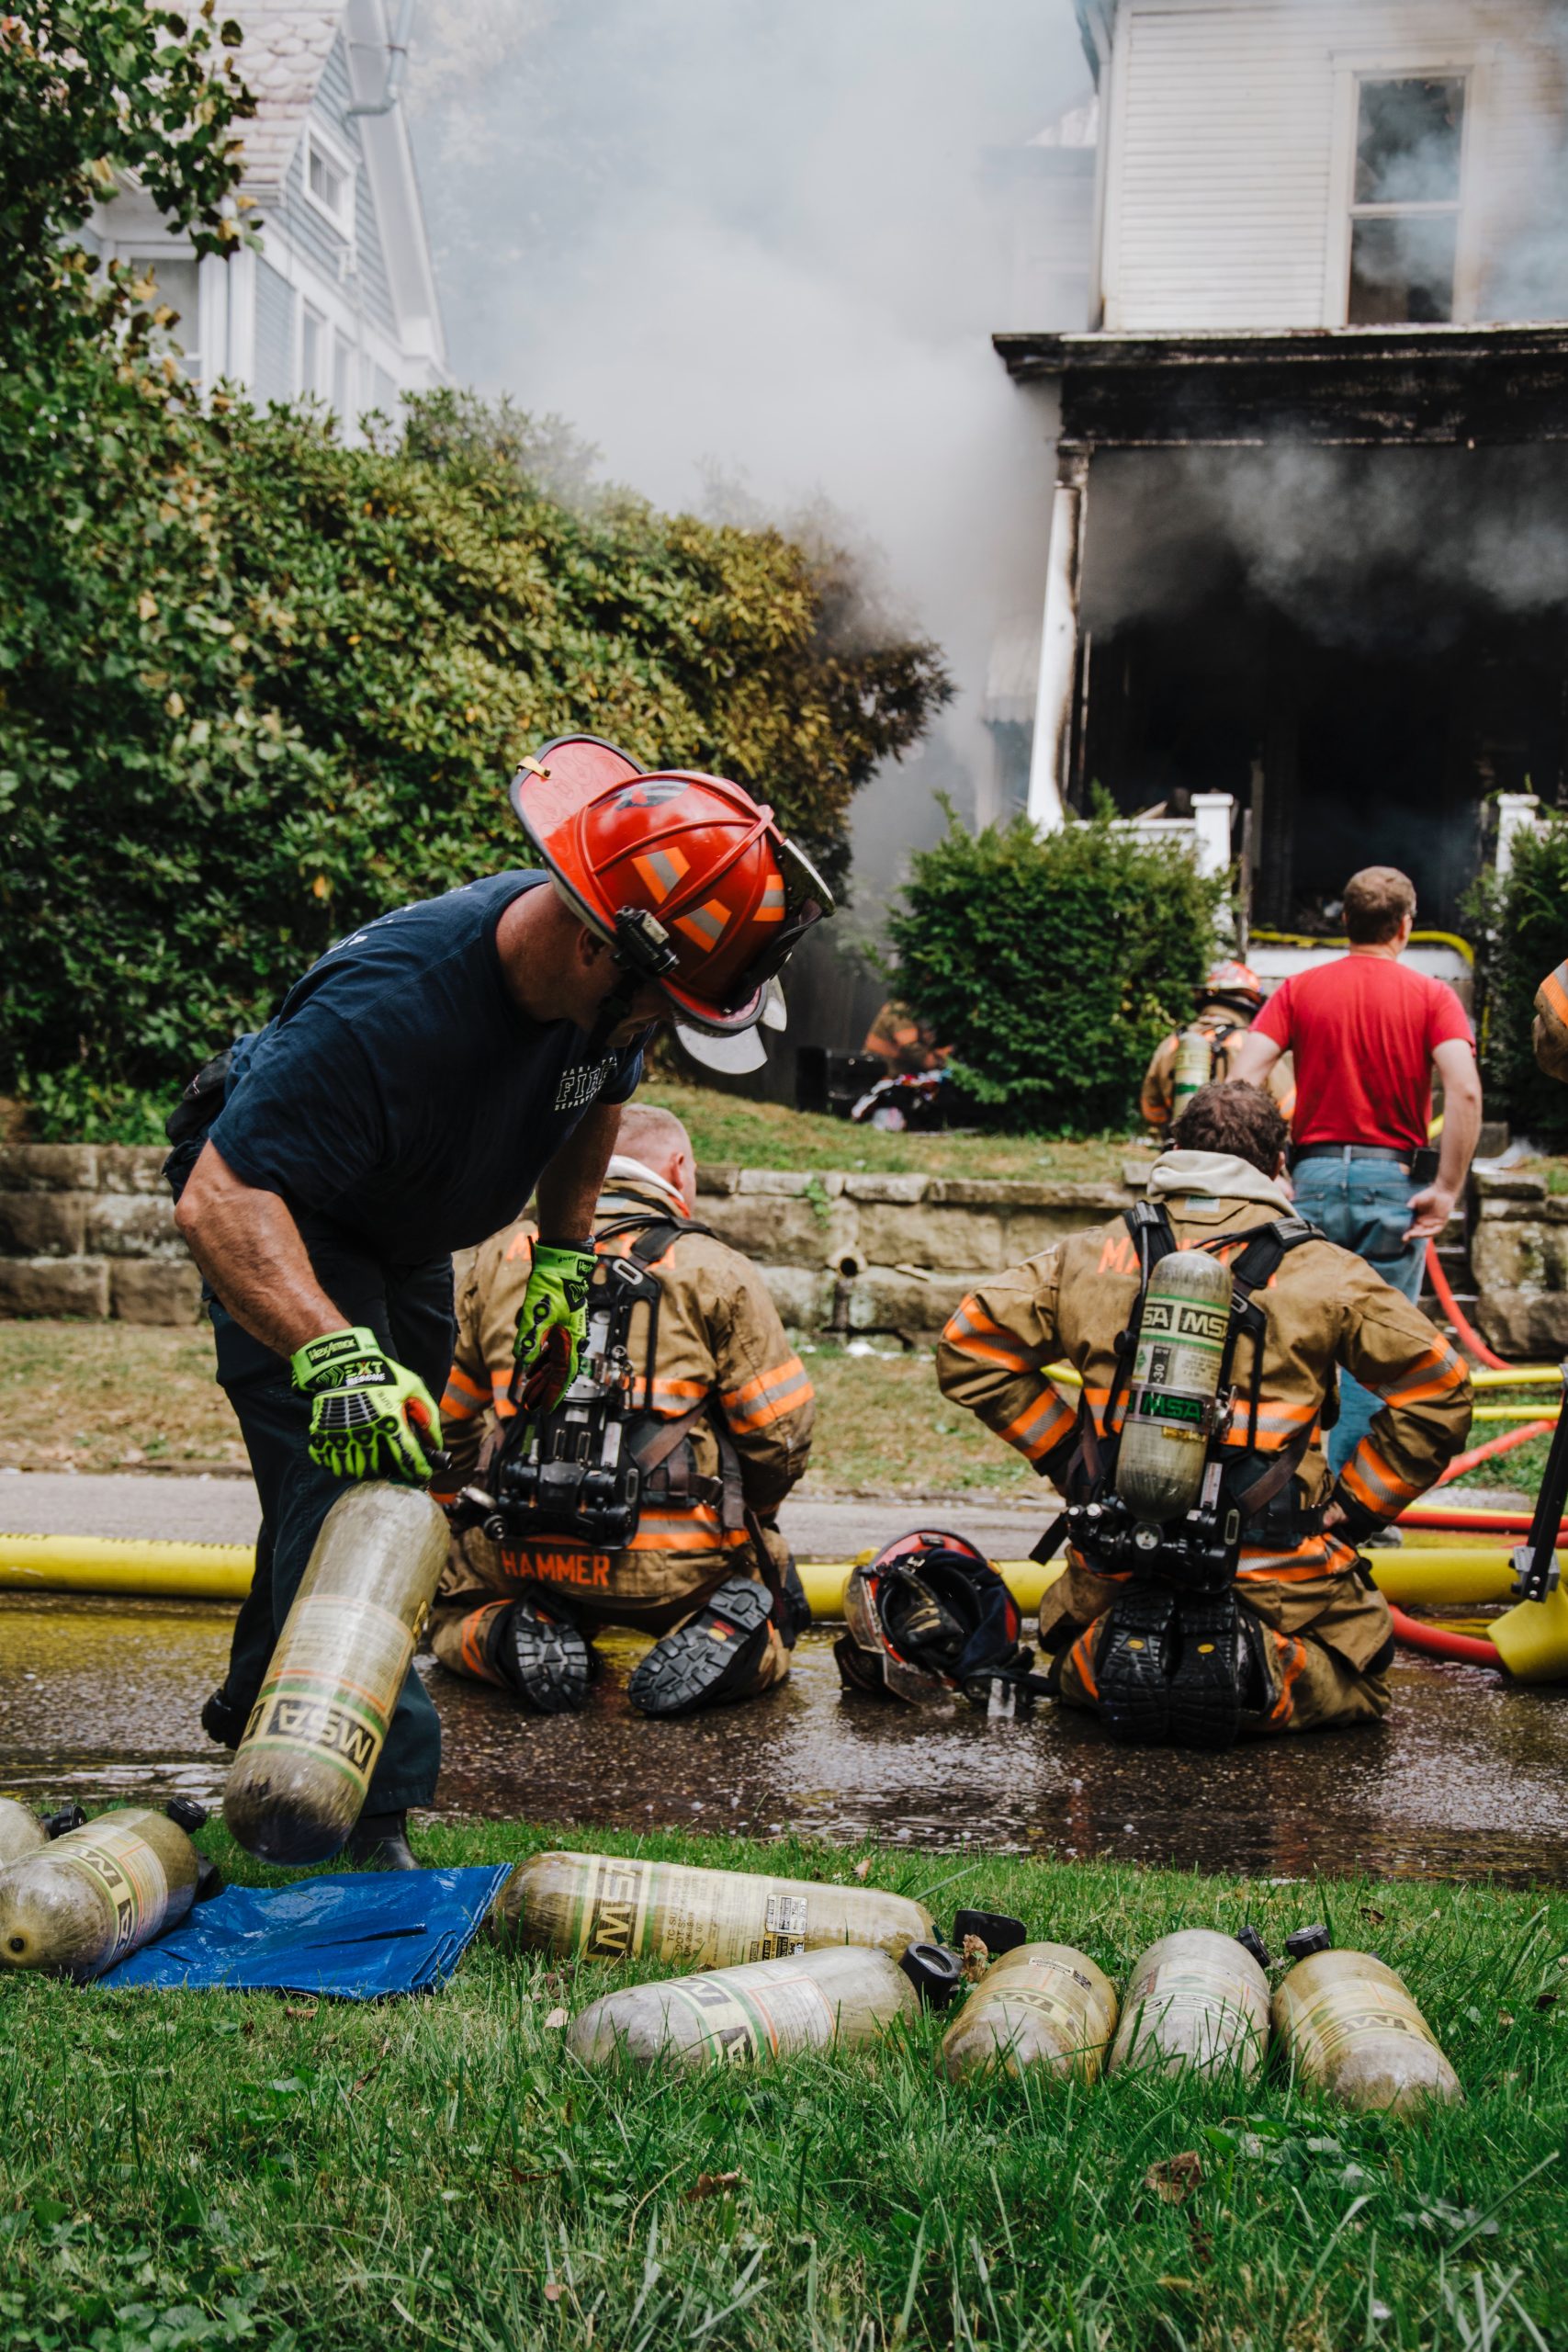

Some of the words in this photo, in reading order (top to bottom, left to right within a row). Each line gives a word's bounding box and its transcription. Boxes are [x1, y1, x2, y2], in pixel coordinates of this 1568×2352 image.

[1142, 1306, 1168, 1329] SA
[344, 1361, 383, 1378] EXT
[1143, 1394, 1201, 1422] MSA
[501, 1549, 611, 1588] HAMMER
[278, 1703, 373, 1765] MSA
